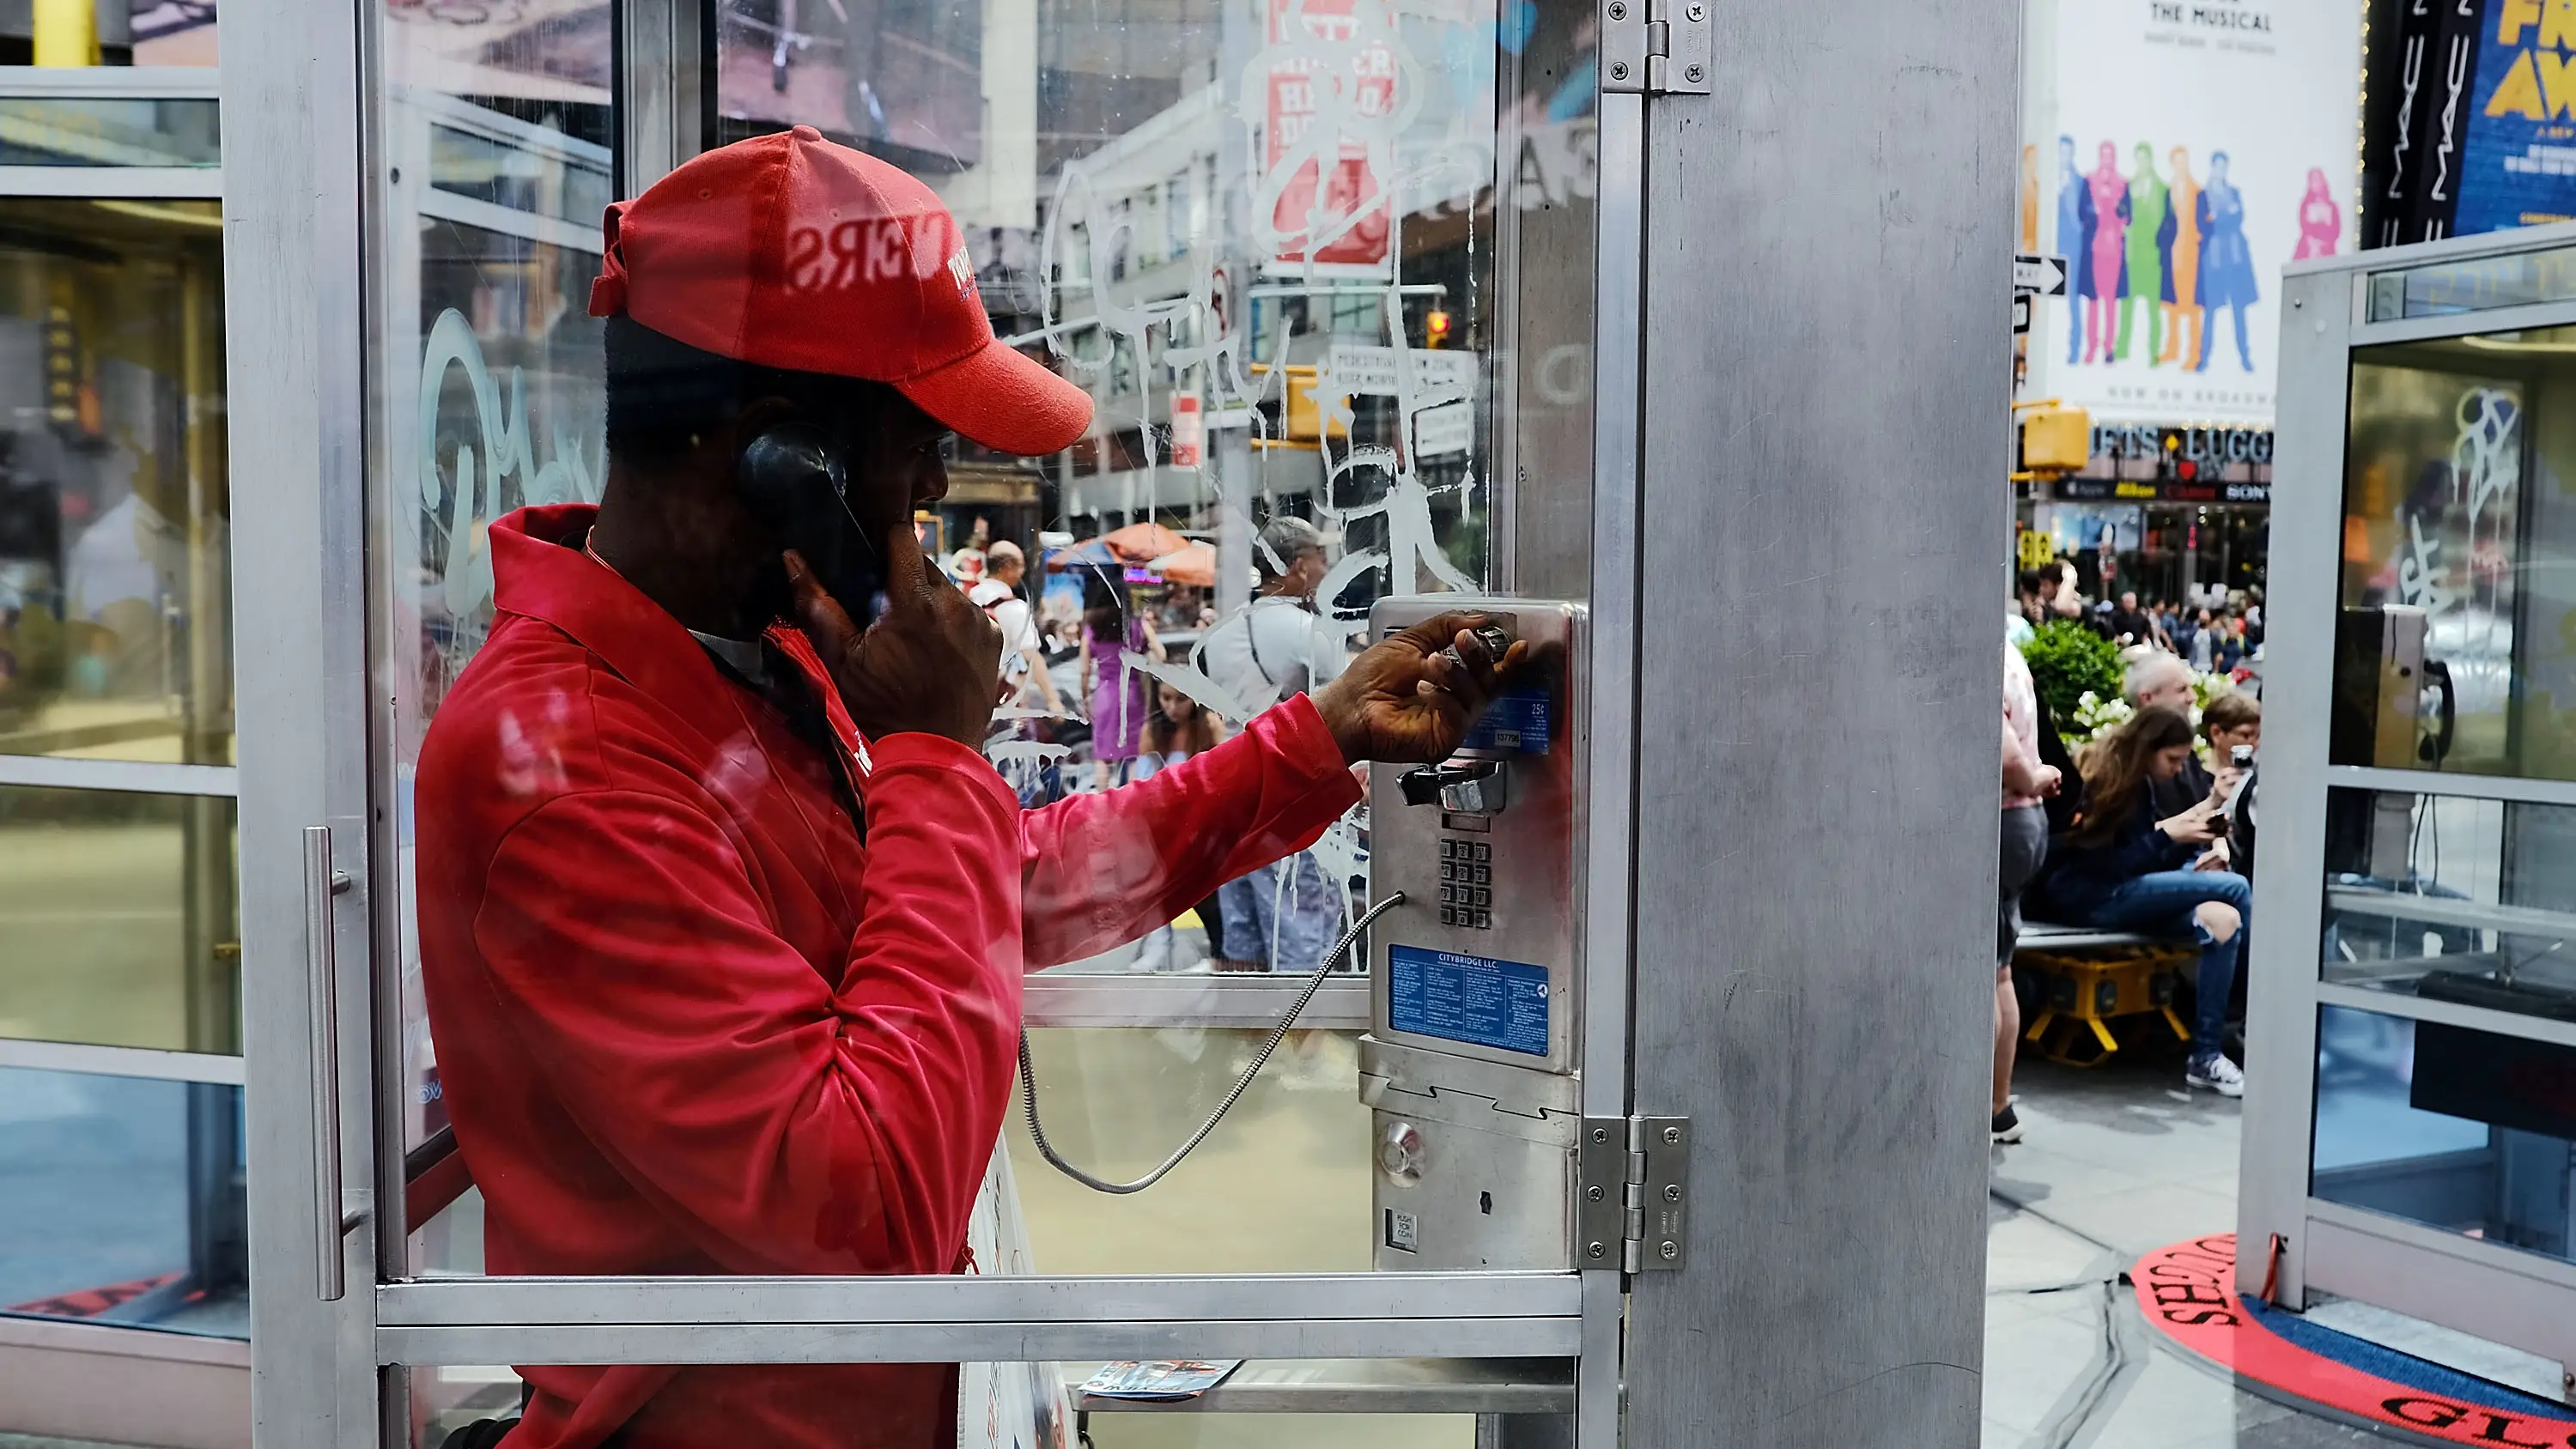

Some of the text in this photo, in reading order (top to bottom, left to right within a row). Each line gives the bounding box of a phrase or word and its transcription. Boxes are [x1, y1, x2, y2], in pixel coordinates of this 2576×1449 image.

[2151, 3, 2184, 22] THE
[2087, 423, 2274, 464] IFTS LUGG
[1532, 703, 1545, 715] 25¢
[1438, 953, 1482, 967] CITYBRIDGE
